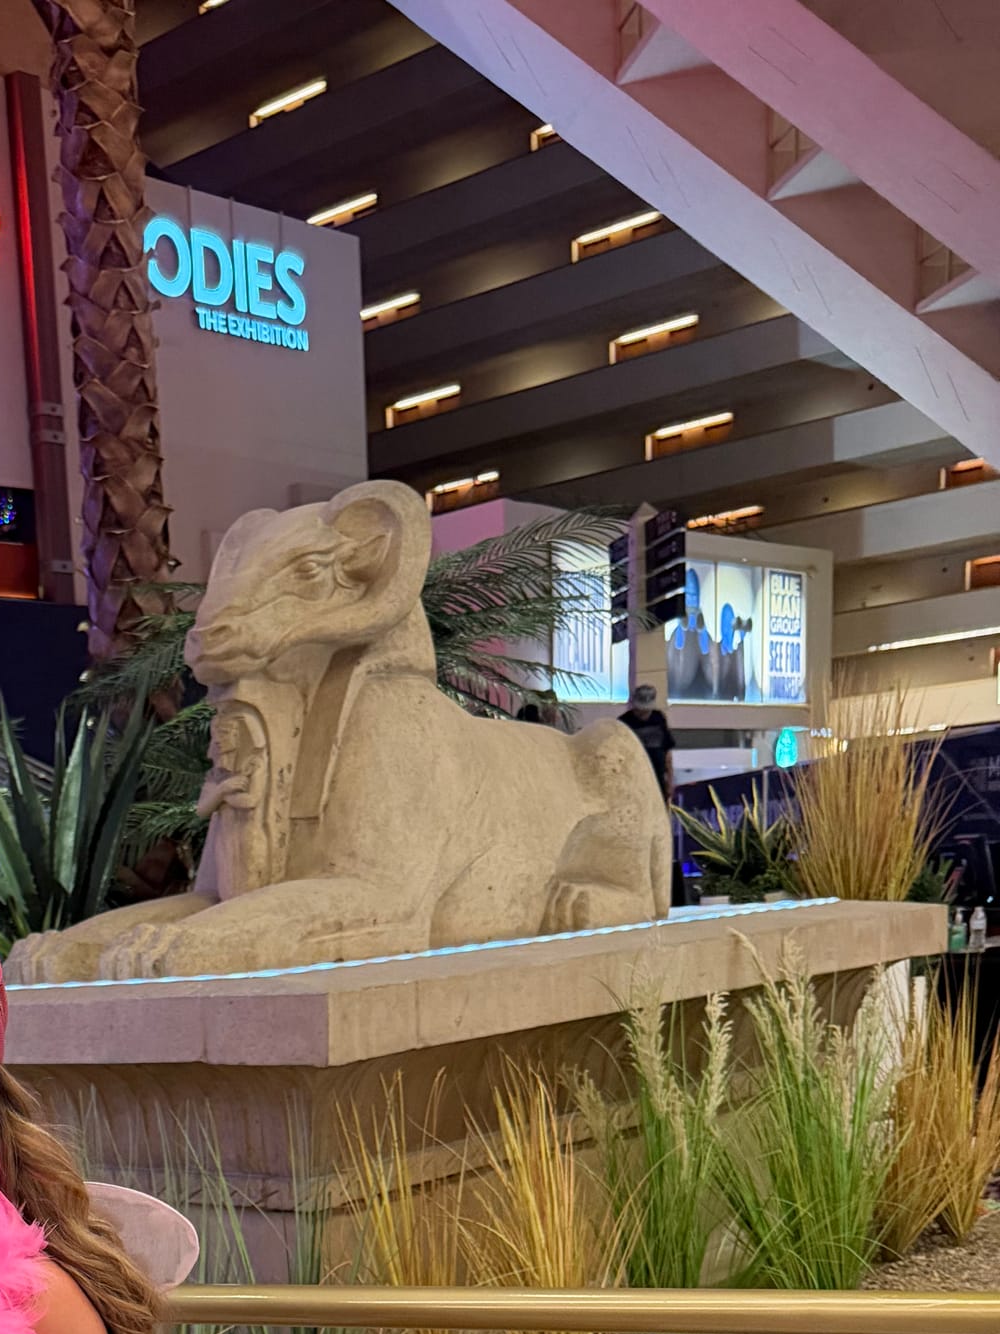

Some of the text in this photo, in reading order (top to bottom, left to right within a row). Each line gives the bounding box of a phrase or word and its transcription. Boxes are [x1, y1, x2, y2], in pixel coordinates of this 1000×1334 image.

[195, 306, 310, 352] THE EXHIBITION
[770, 573, 801, 597] BLUE
[770, 594, 801, 619] MAN
[770, 618, 801, 635] GROUP
[769, 641, 801, 673] SEE FOR
